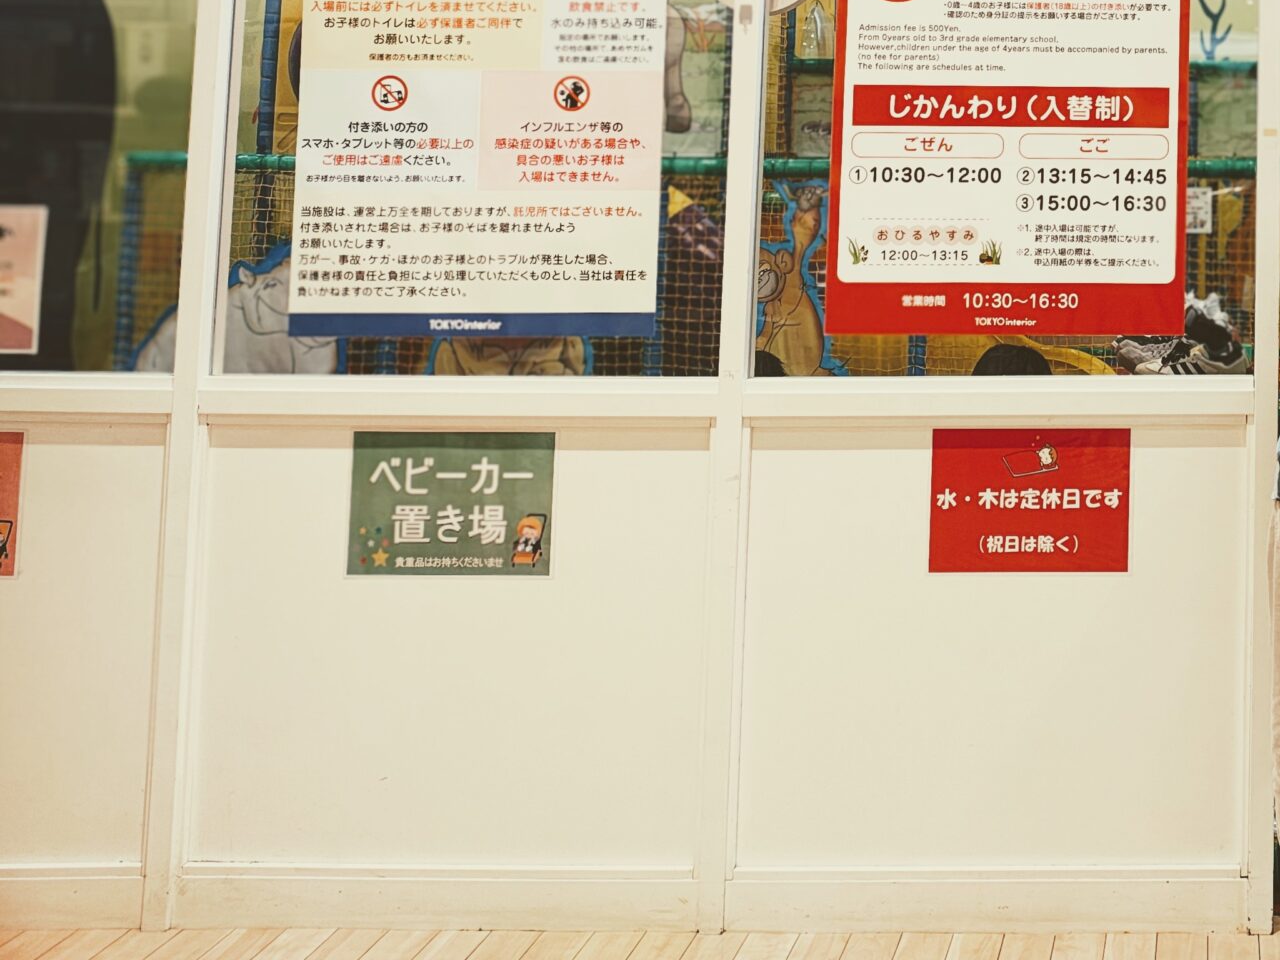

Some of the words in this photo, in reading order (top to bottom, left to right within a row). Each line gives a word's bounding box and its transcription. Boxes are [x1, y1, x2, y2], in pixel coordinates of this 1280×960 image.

[310, 1, 538, 12] 入場前には必ずトイレを済ませてください。
[324, 17, 523, 29] お子様のトイレは必ず保護者ご同伴で
[551, 18, 663, 29] 水のみ持ち込み可能。
[374, 34, 471, 45] お願いいたします。
[982, 35, 1027, 43] elementary
[875, 63, 913, 71] following
[888, 94, 1133, 122] じかんわり（入替制）
[349, 122, 428, 133] 付き添いの方の
[520, 121, 623, 133] インフルエンザ等の
[302, 138, 474, 149] スマホ・タブレット等の必要以上の
[494, 138, 646, 150] 感染症の疑いがある場合や、
[904, 137, 953, 152] ごぜん
[1080, 138, 1111, 154] ごご
[323, 155, 451, 166] ご使用はご遠慮ください。
[516, 154, 624, 166] 具合の悪いお子様は
[519, 171, 620, 183] 入場はできません。
[877, 228, 975, 241] おひるやすみ
[300, 238, 391, 249] お願いいたします。
[880, 249, 968, 261] 12:00～13:15
[962, 293, 1079, 309] 10:30～16:30
[369, 457, 534, 494] ベビーカー
[937, 488, 1122, 509] 水・木は定休日です
[392, 504, 507, 544] 置き場
[979, 536, 1078, 553] （祝日は除く）
[395, 557, 503, 568] 貴重品はお持ちくださいませ
